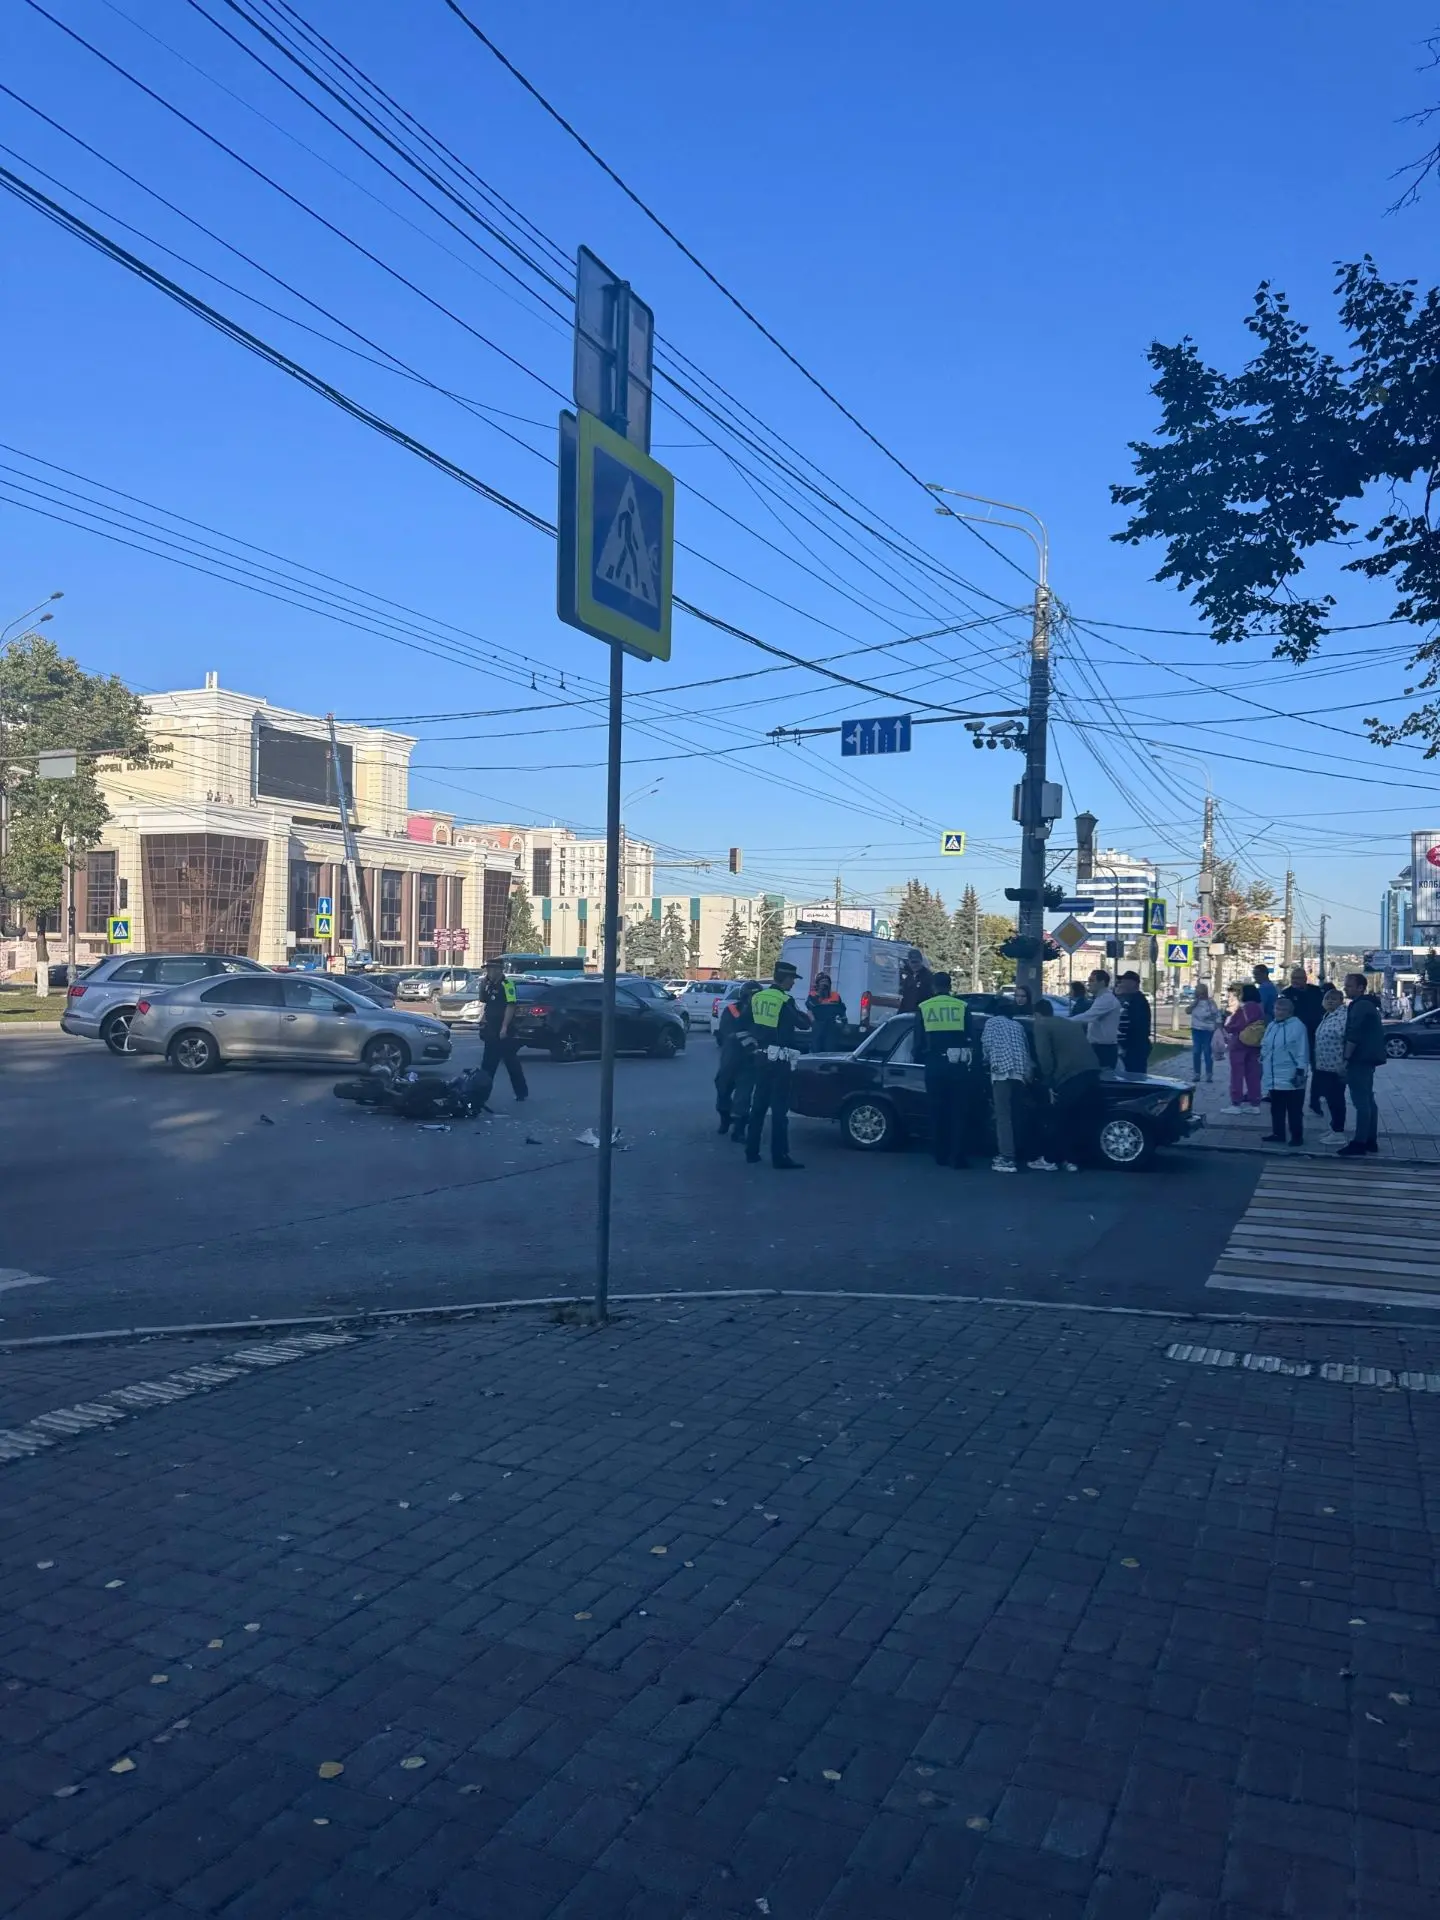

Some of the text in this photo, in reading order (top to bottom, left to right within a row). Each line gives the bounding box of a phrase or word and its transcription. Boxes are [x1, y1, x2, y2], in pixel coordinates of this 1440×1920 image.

[94, 759, 174, 773] ОРЕЦ КУЛЬТУРЫ
[1418, 880, 1440, 889] КОЛБ
[753, 1000, 777, 1018] ДПС
[926, 1007, 961, 1022] ДПС
